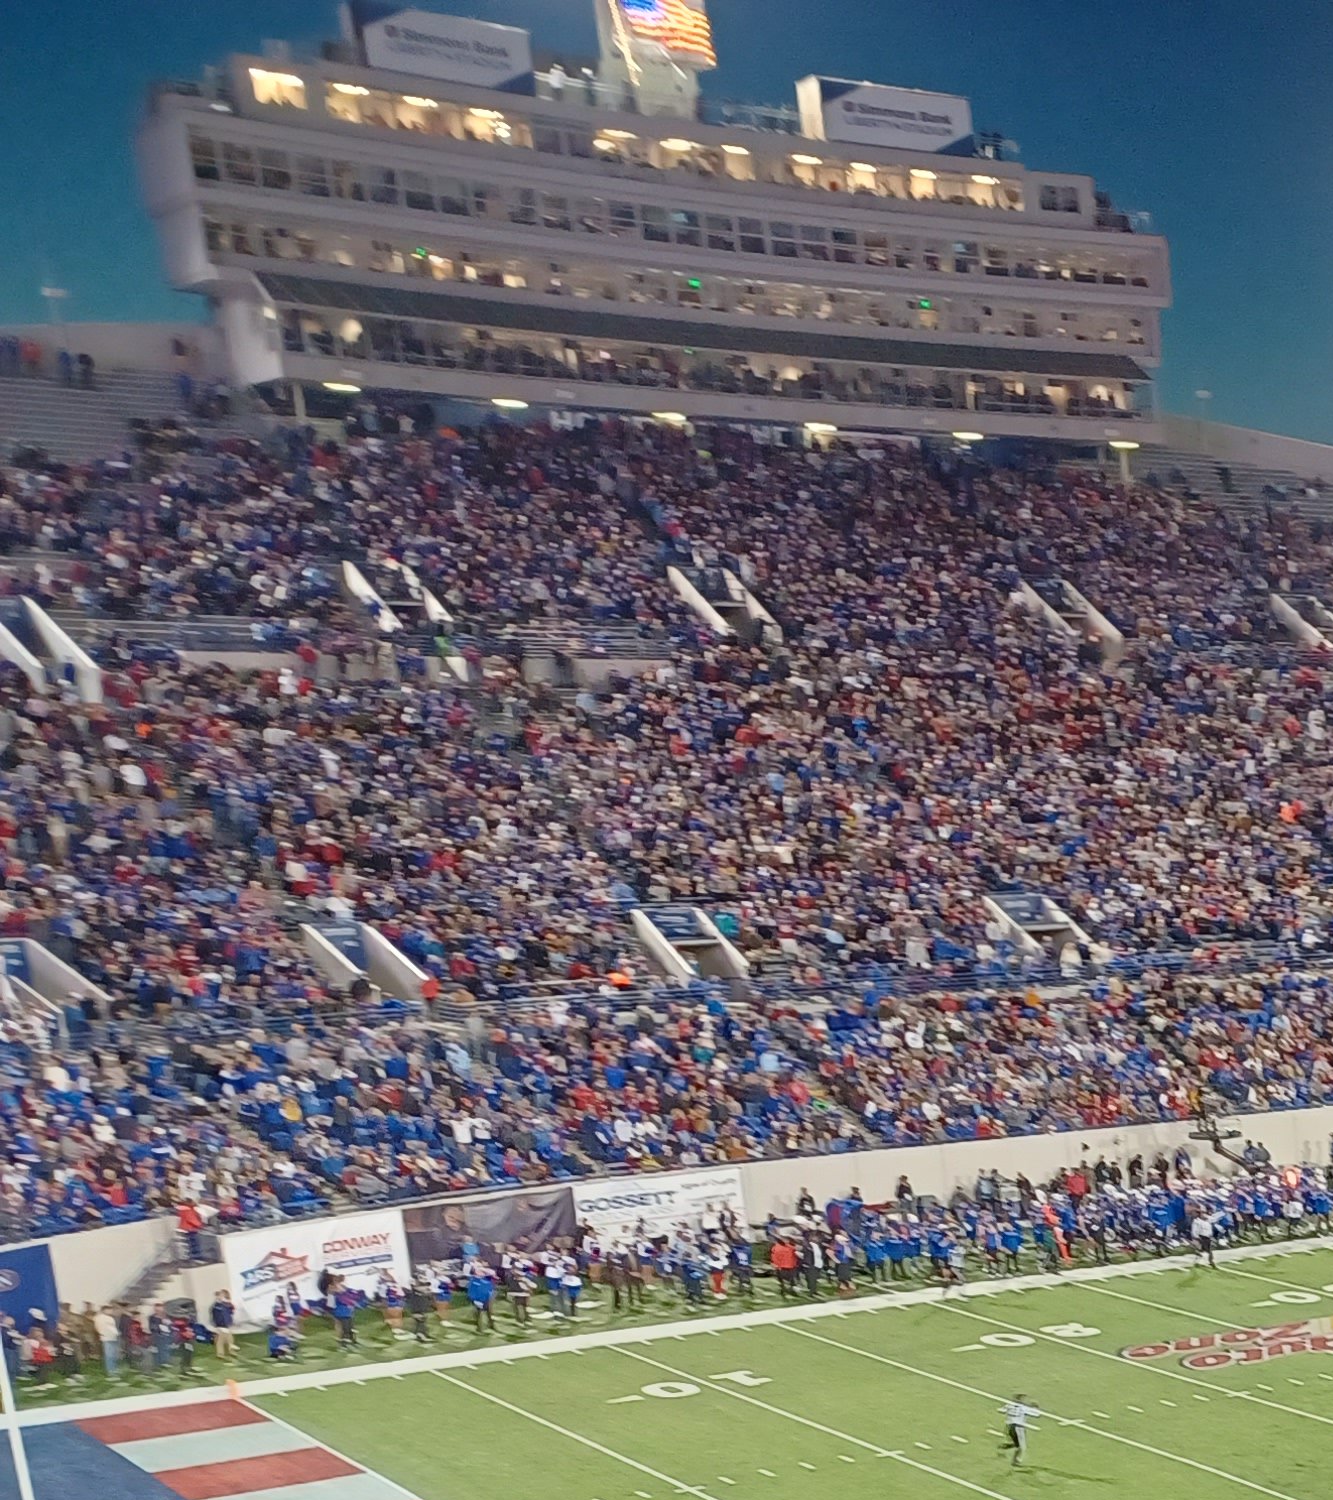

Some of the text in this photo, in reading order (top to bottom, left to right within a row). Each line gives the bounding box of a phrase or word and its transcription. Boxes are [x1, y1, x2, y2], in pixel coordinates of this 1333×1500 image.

[578, 1191, 676, 1213] GOSSETT
[321, 1232, 391, 1254] CONWAY
[1121, 1319, 1310, 1360] Zone
